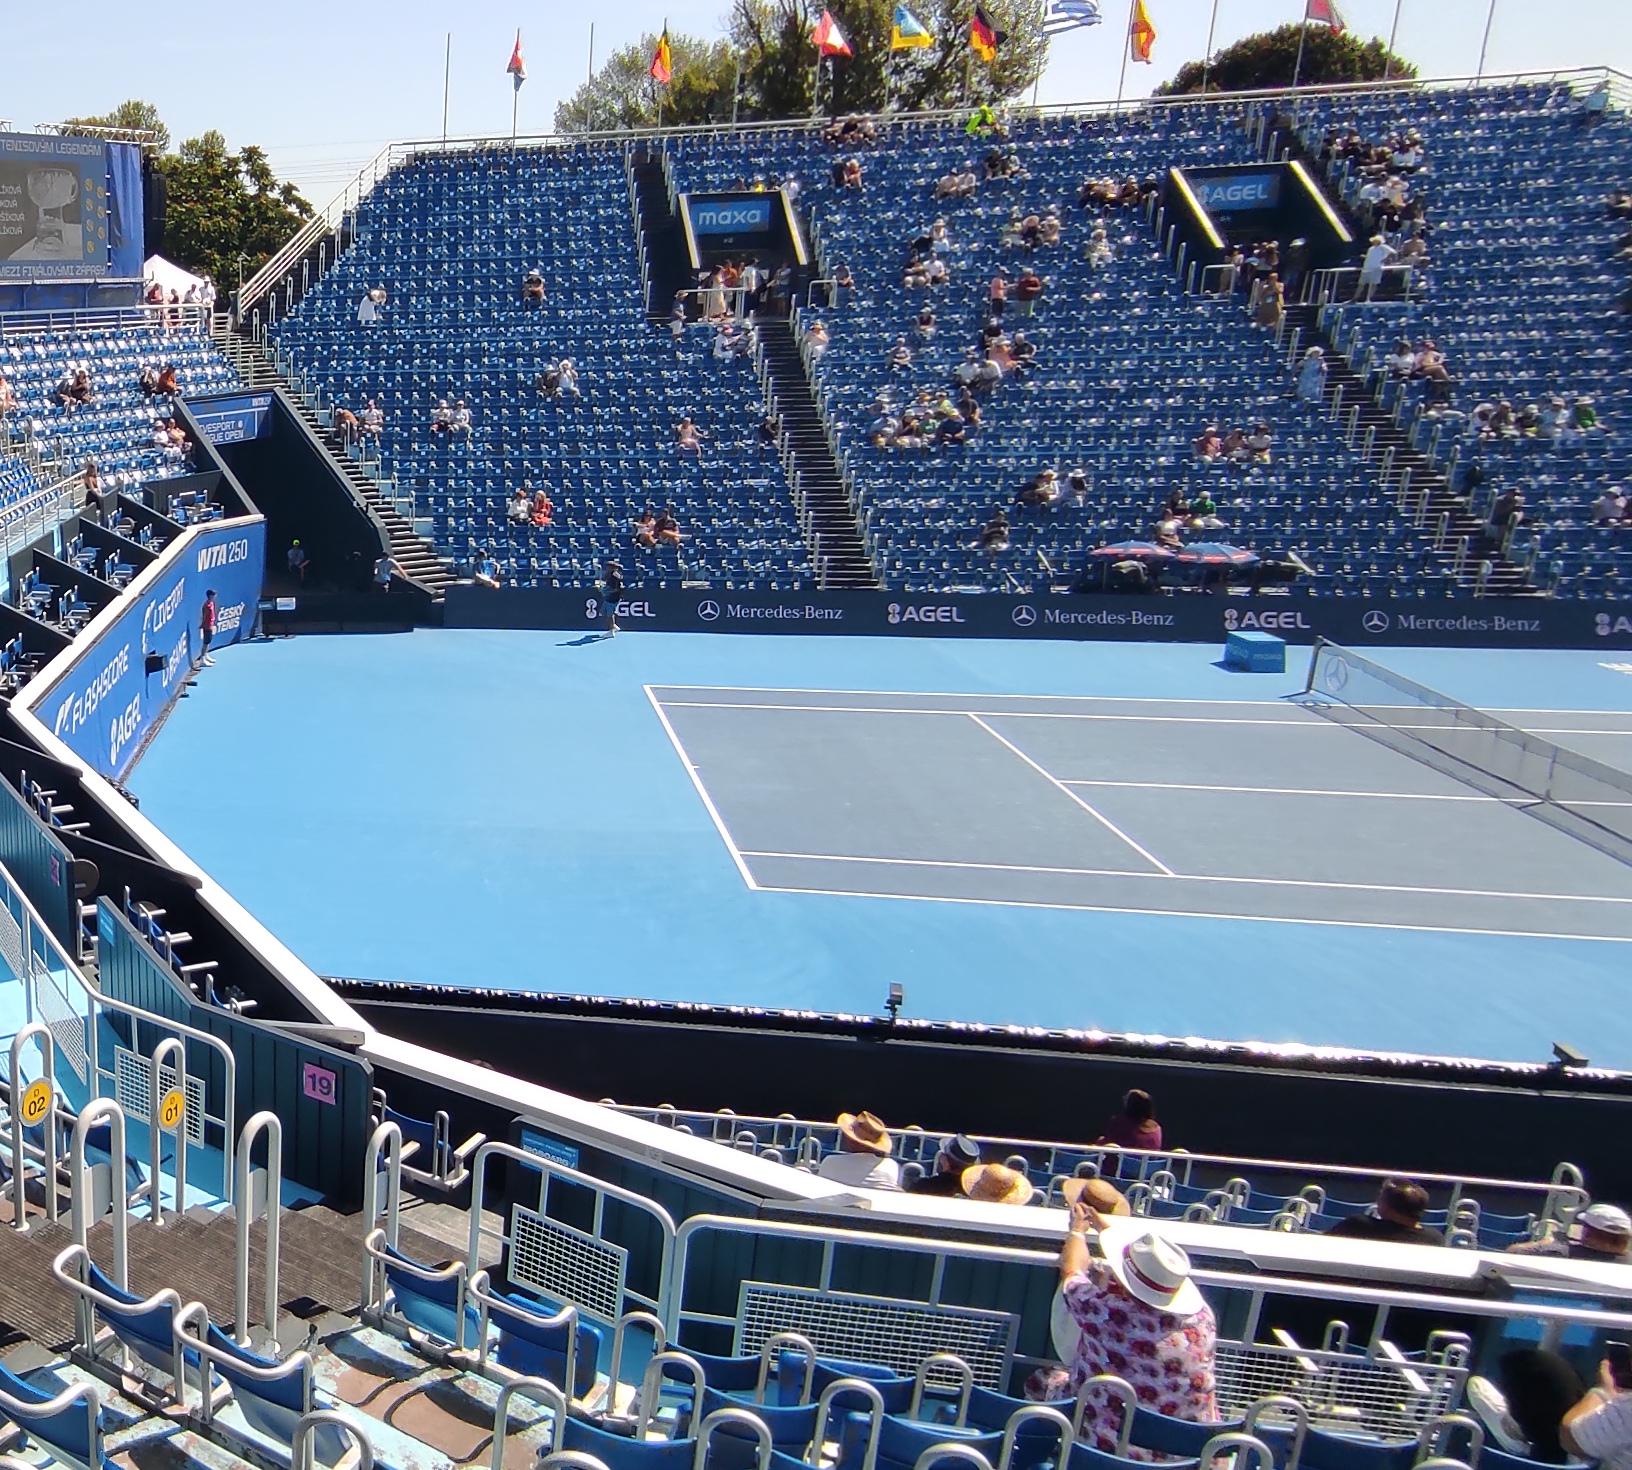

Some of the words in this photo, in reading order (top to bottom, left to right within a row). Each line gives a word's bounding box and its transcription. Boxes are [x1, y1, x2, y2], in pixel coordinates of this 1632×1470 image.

[1209, 184, 1268, 203] AGEL
[699, 209, 761, 225] maxa
[197, 543, 227, 572] WTA
[228, 538, 248, 562] 250
[726, 603, 843, 620] Mercedes-Benz
[901, 606, 966, 623] AGEL
[1043, 608, 1174, 626] Mercedes-Benz
[1240, 610, 1311, 629] AGEL
[216, 617, 241, 633] TENIS
[1397, 614, 1541, 632] Mercedes-Benz
[72, 643, 130, 735] FLASHSCORE
[116, 692, 142, 753] AGEL
[307, 1073, 332, 1095] 19
[28, 1096, 46, 1116] 02
[165, 1103, 178, 1122] 01
